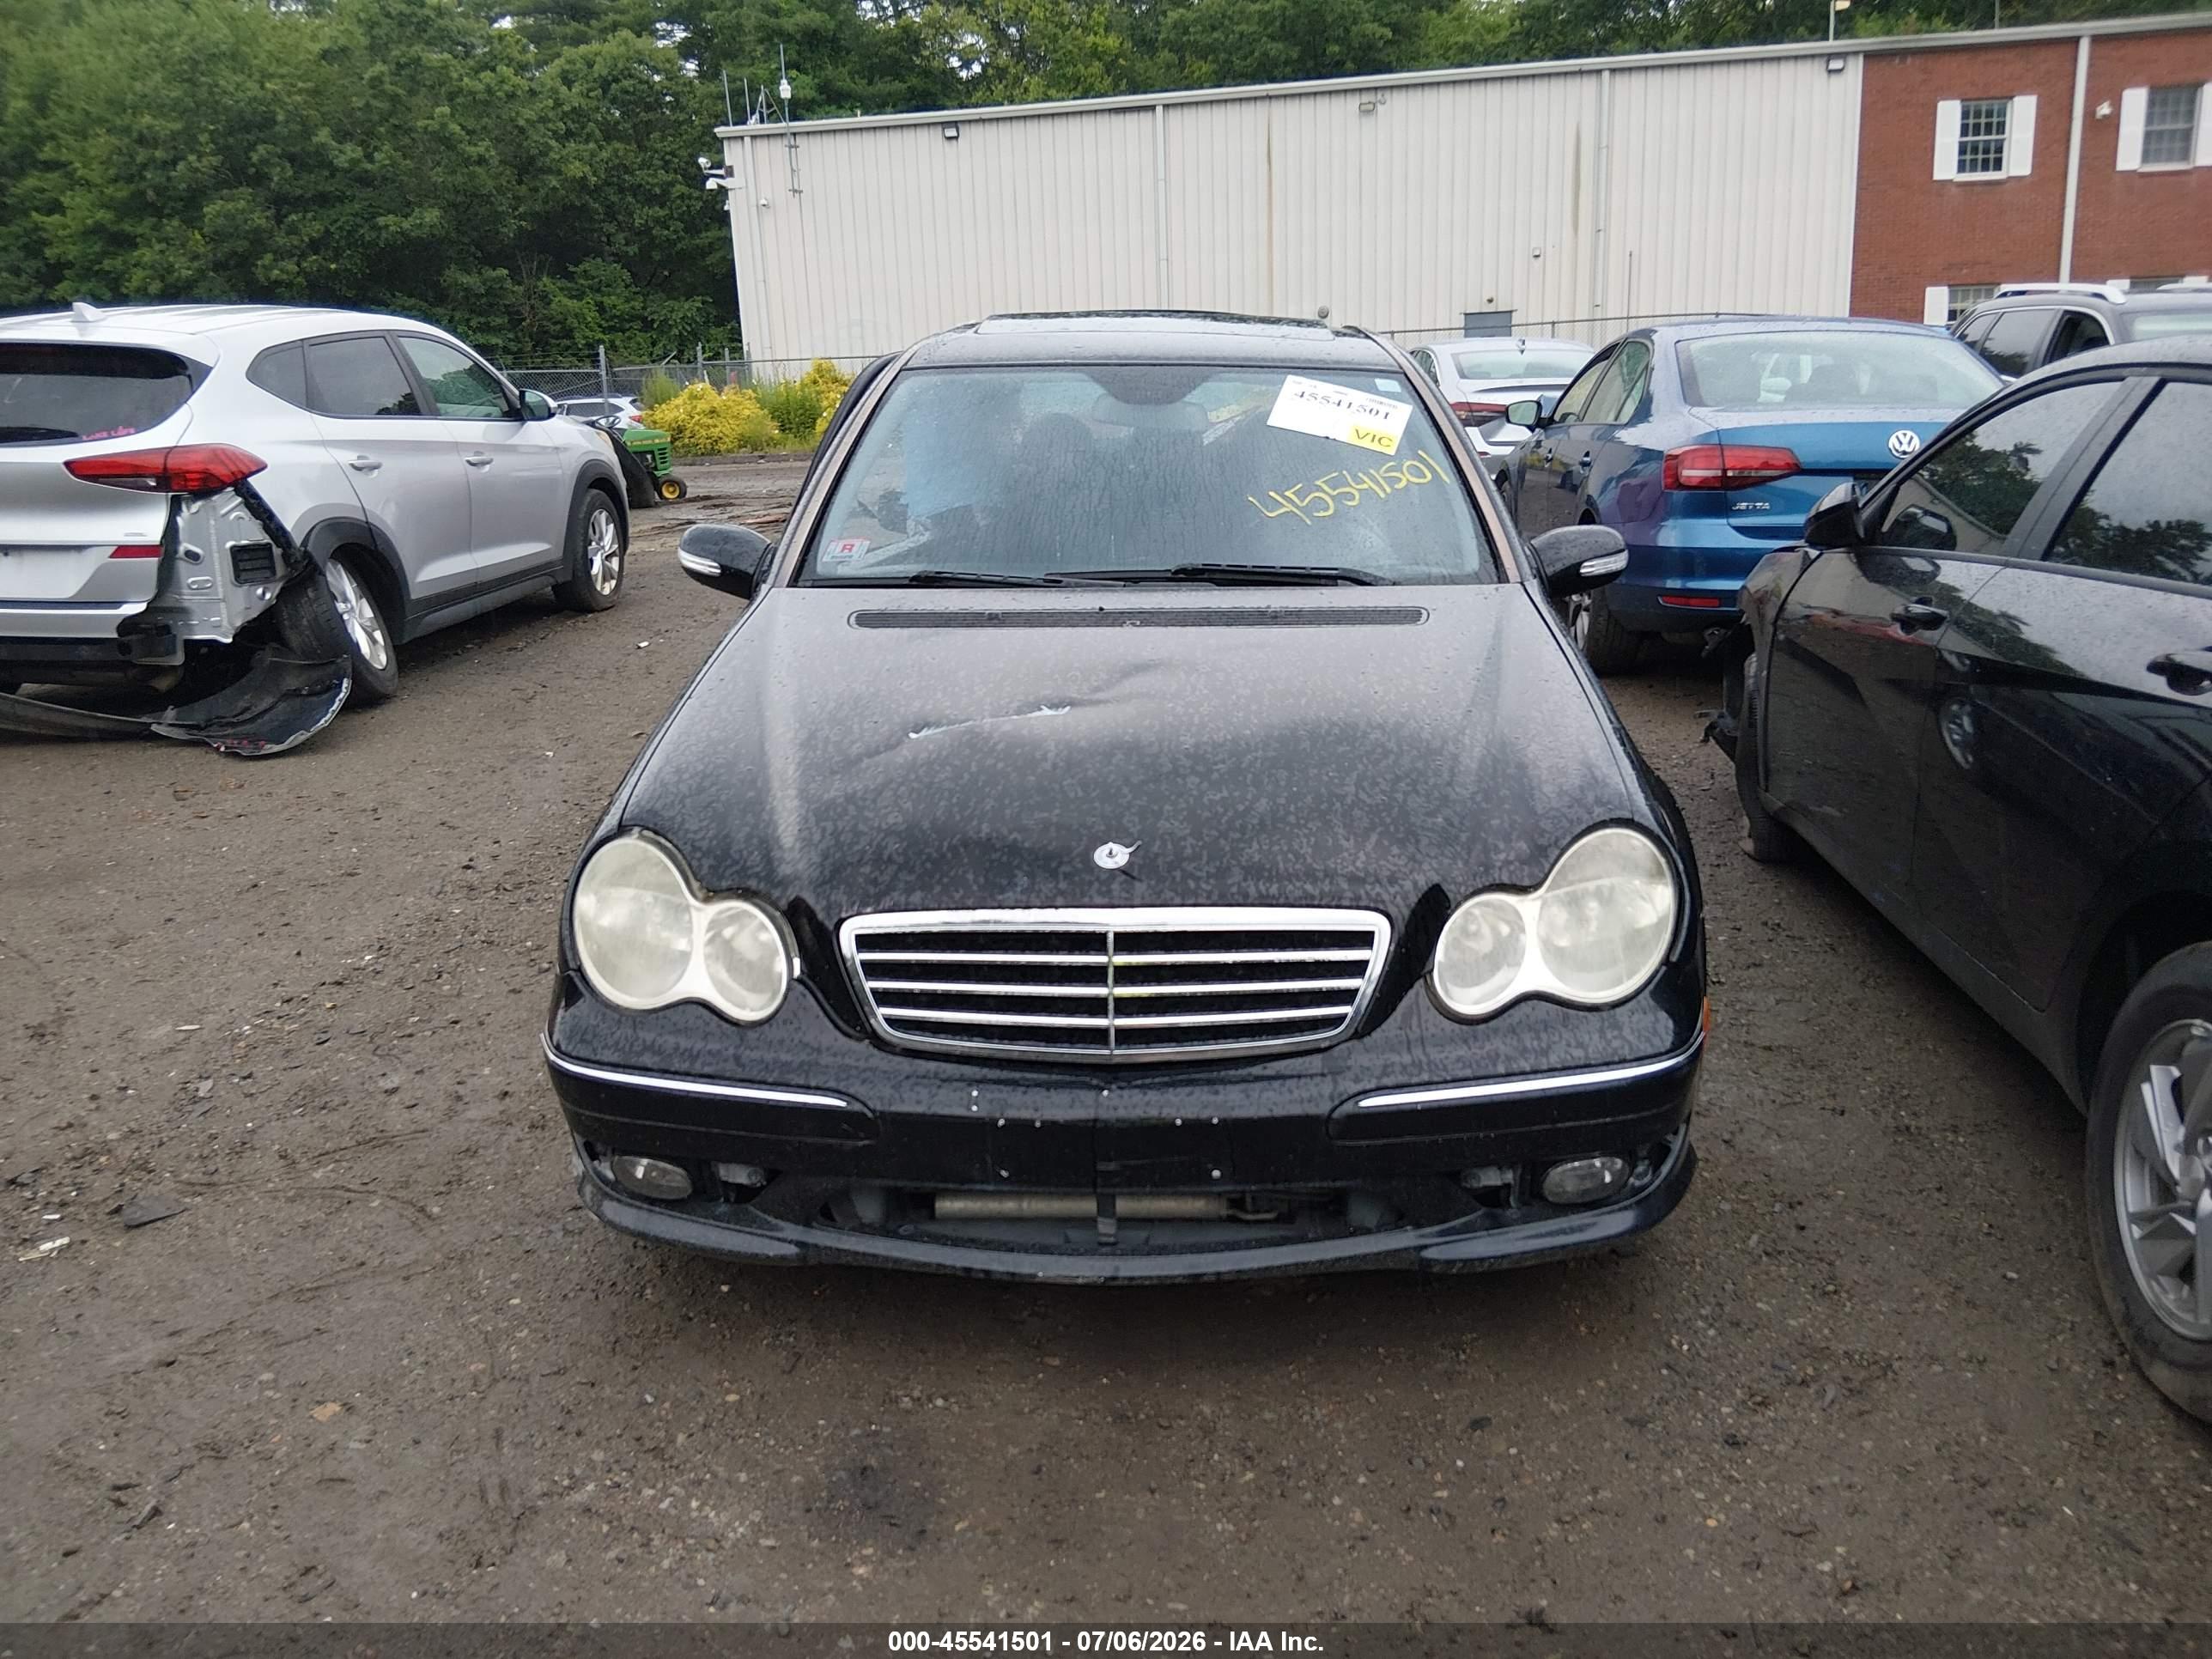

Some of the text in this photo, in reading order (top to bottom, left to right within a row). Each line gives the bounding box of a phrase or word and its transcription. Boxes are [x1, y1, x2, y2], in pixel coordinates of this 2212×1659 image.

[1294, 390, 1390, 420] 45541501
[1354, 428, 1394, 448] VIC
[1247, 449, 1450, 526] 45541501
[1731, 501, 1771, 511] JETTA
